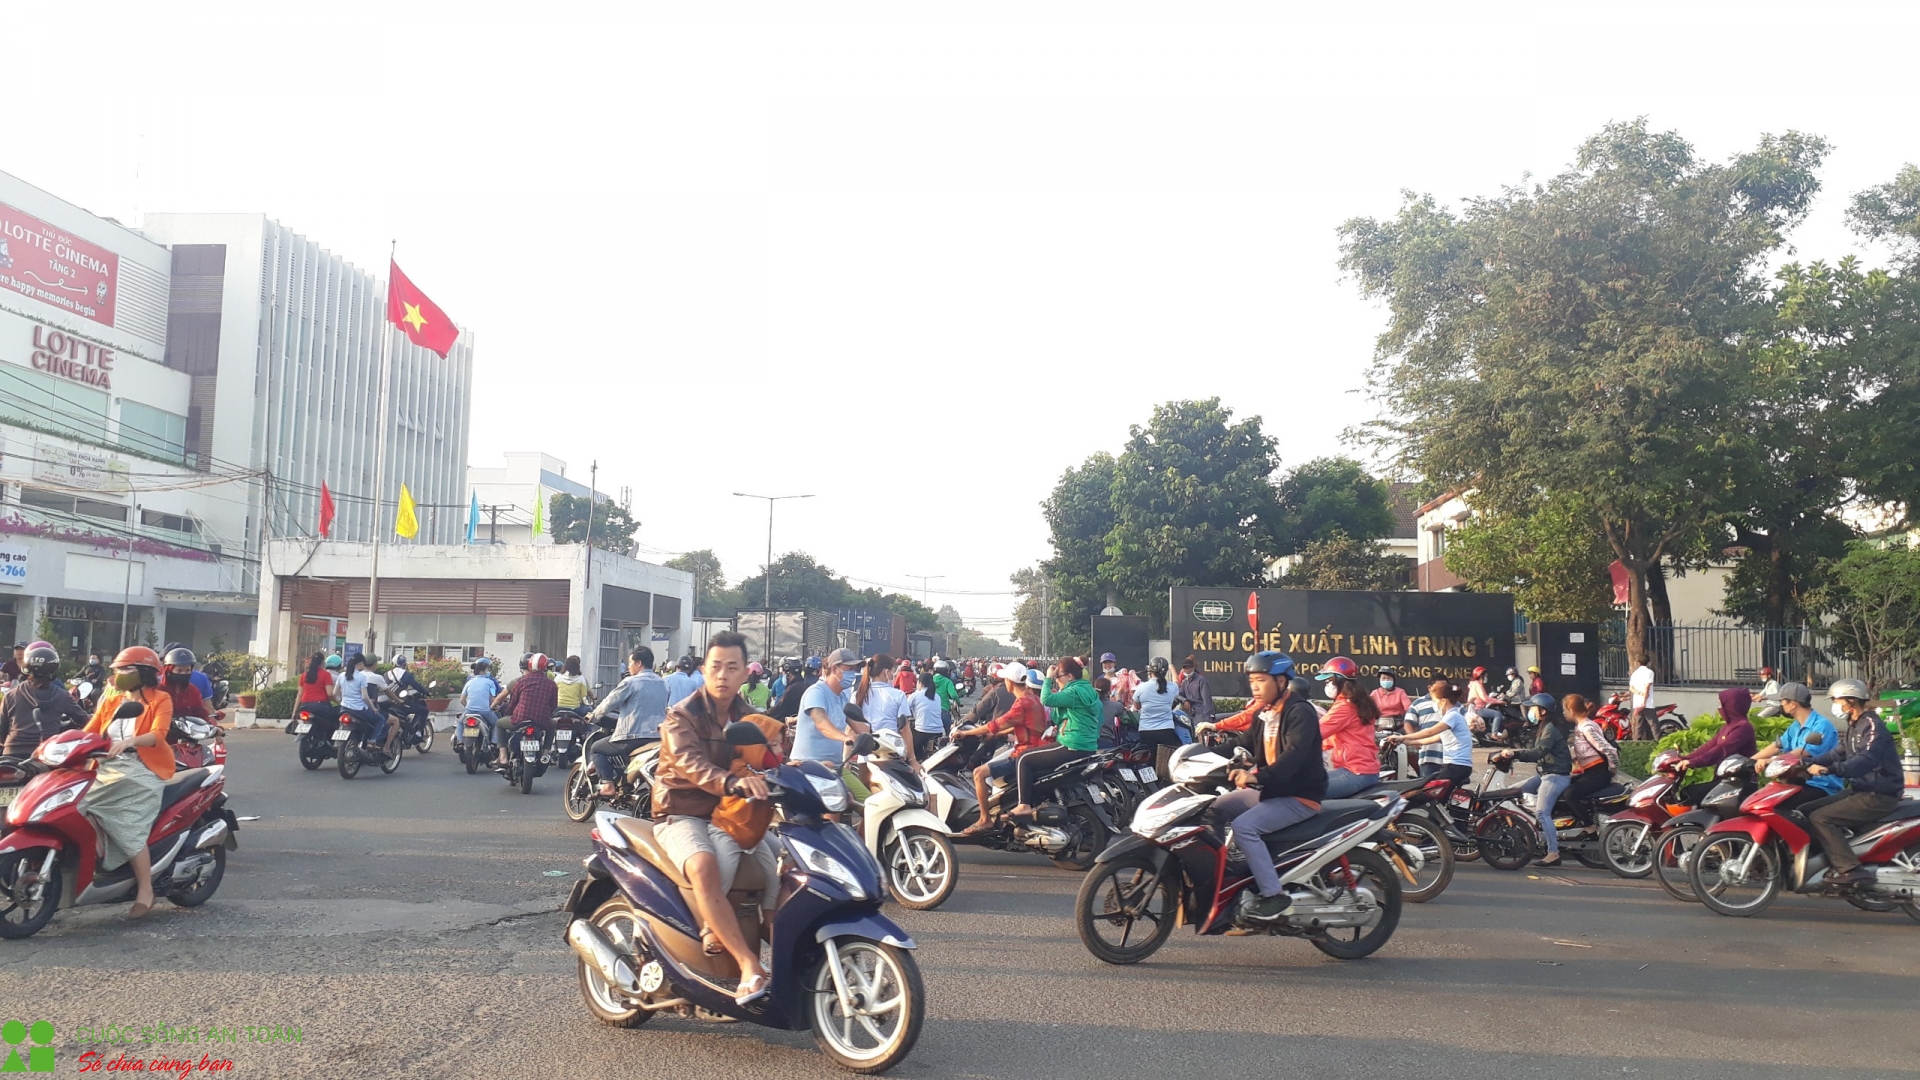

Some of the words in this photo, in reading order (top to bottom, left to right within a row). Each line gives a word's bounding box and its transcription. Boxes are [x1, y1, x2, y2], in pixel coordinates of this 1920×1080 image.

[5, 221, 52, 253] LOTTE
[55, 243, 109, 276] CINEMA
[70, 268, 76, 278] 2
[11, 276, 36, 296] happy
[36, 288, 74, 309] memories
[75, 301, 96, 316] begin
[33, 325, 114, 370] LOTTE
[32, 351, 111, 389] CINEMA
[0, 564, 26, 577] -766
[1192, 630, 1235, 651] KHU
[1241, 622, 1283, 652] CHẾ
[1288, 624, 1343, 654] XUẤT
[1349, 634, 1398, 656] LINH
[1403, 635, 1477, 658] TRUNG
[1485, 637, 1495, 658] 1
[1203, 660, 1232, 672] LINH
